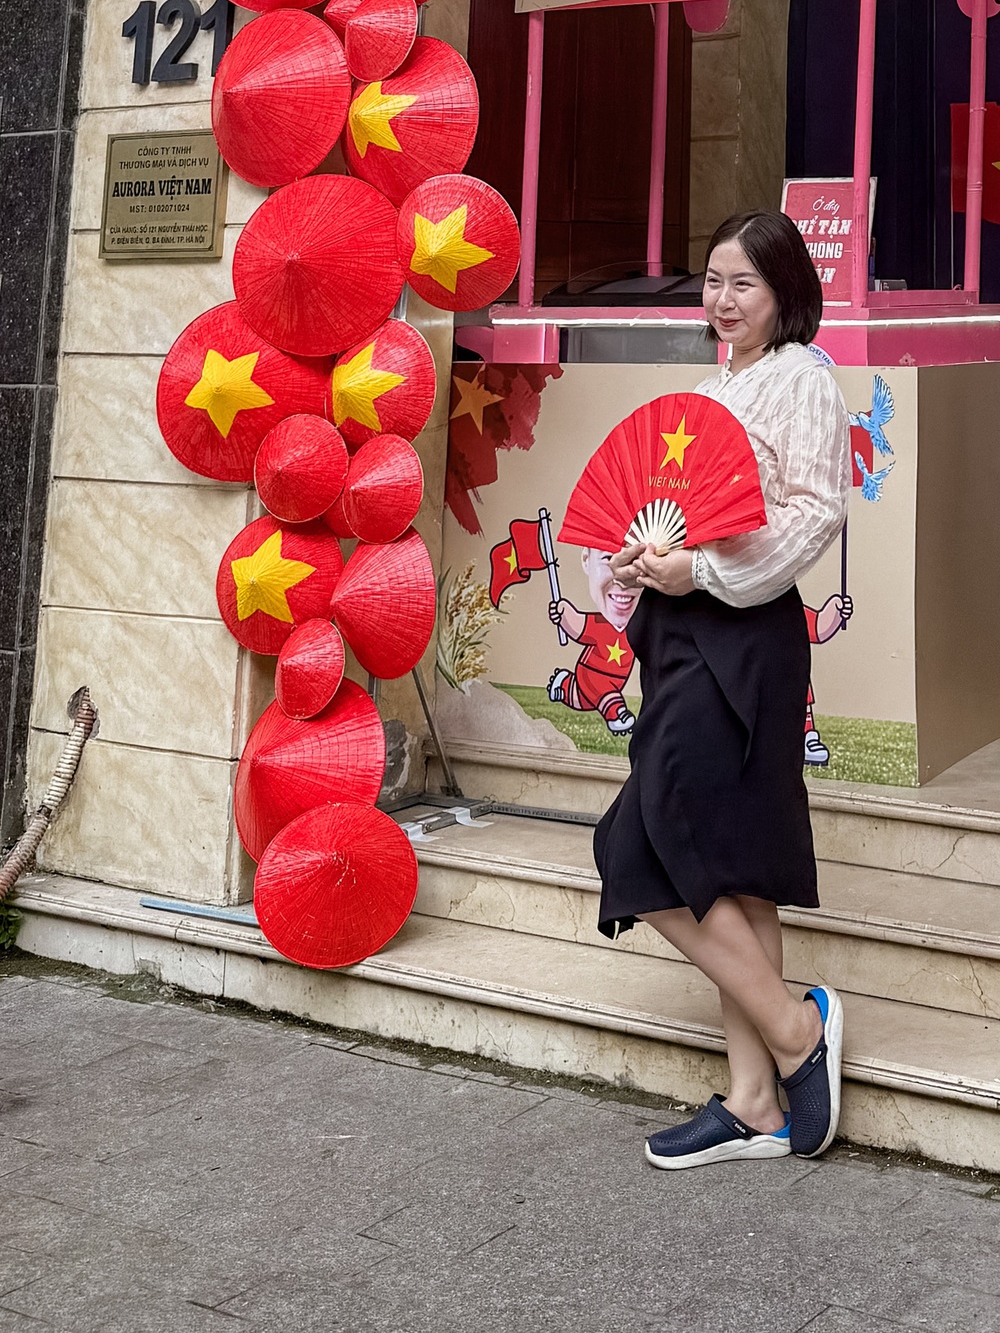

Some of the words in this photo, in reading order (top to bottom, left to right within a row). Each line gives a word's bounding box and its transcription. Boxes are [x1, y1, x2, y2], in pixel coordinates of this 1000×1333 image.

[138, 146, 159, 156] CÔNG
[161, 147, 170, 155] TY
[172, 146, 192, 155] TNHH
[119, 160, 151, 169] THƯƠNG
[152, 160, 166, 170] MẠI
[167, 157, 177, 167] VÀ
[179, 158, 197, 169] DỊCH
[199, 158, 209, 168] VỤ
[112, 180, 155, 197] AURORA
[158, 175, 184, 200] VIỆT
[185, 178, 212, 195] NAM
[129, 205, 147, 213] MST:
[818, 216, 852, 238] TẶN
[668, 477, 690, 490] NAM
